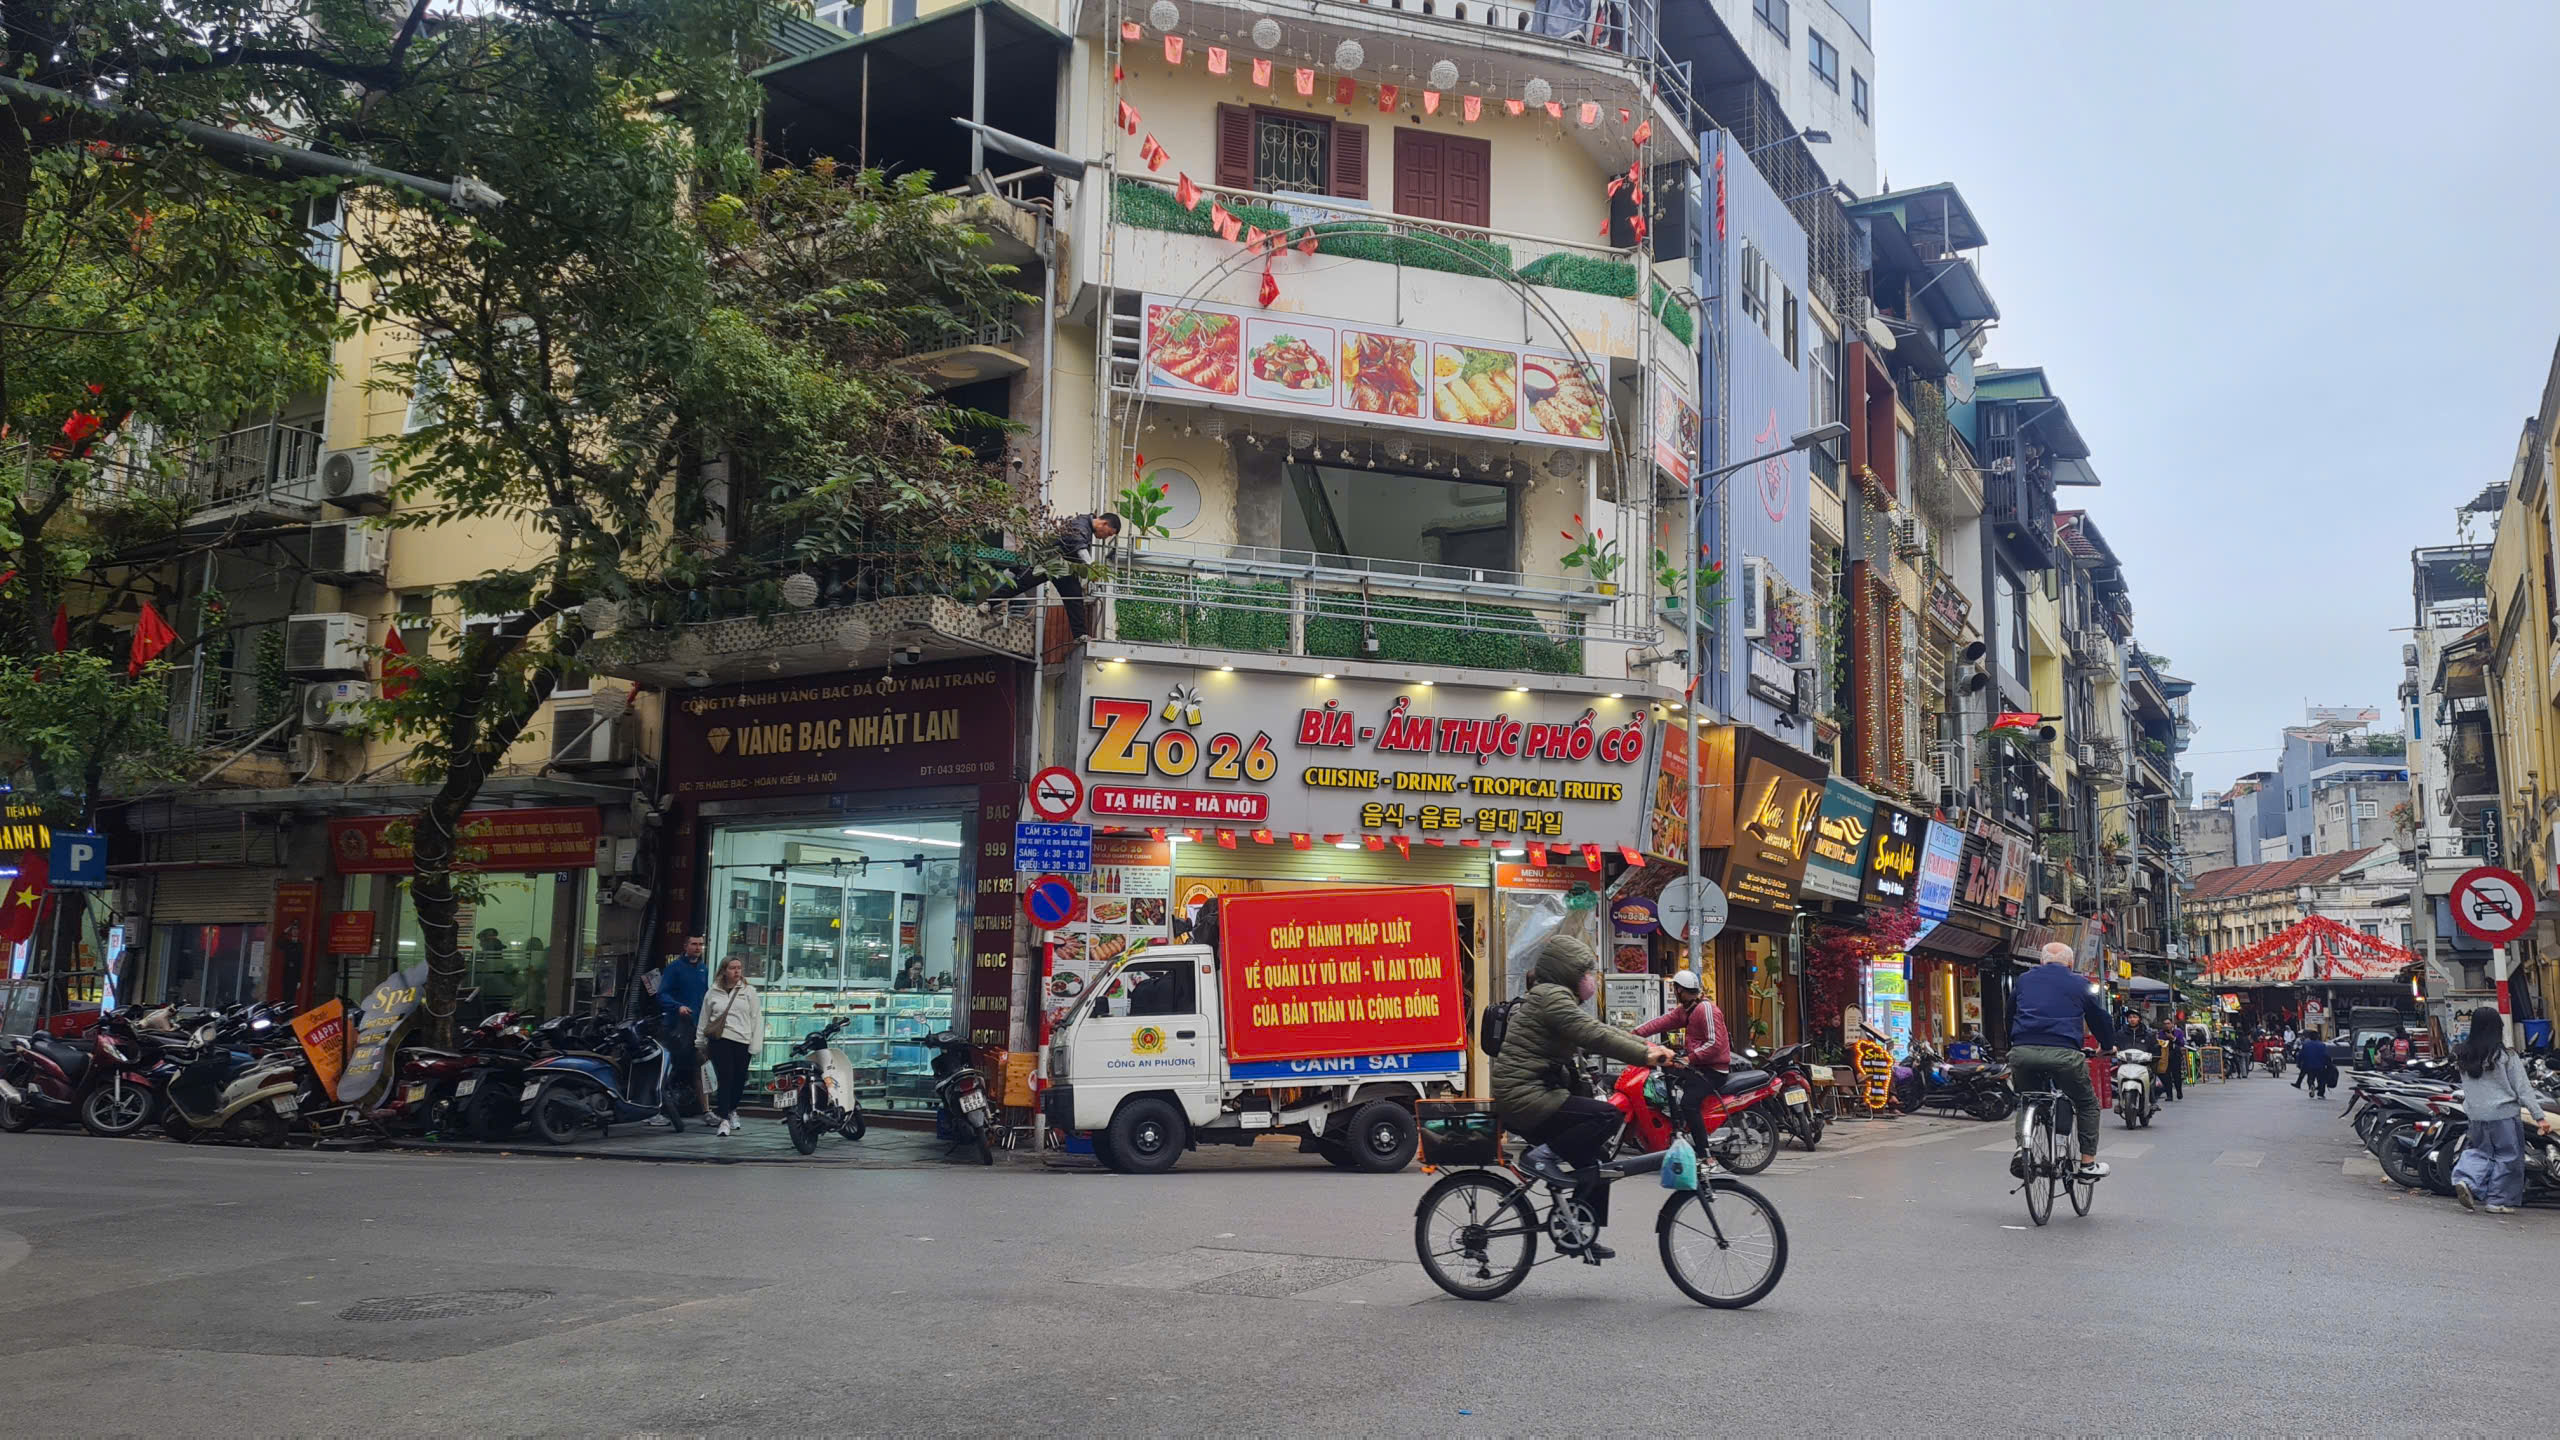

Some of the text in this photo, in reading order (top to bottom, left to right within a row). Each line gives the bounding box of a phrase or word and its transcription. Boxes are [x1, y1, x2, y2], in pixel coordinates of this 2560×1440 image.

[780, 687, 818, 703] VÀNG
[822, 685, 850, 702] BẠC
[853, 680, 873, 696] ĐÁ
[911, 676, 940, 691] MAI
[943, 671, 996, 687] TRANG
[737, 707, 960, 758] VÀNG BẠC NHẬT LAN
[1377, 697, 1436, 752] ẨM
[1438, 714, 1524, 766] THỰC
[1525, 708, 1598, 761] PHỐ
[1600, 710, 1648, 764] CỔ
[937, 765, 953, 776] 043
[955, 763, 976, 774] 9260
[1207, 730, 1278, 784] 26
[1304, 767, 1623, 801] CUISINE DRINK TROPICAL FRUITS
[986, 805, 1010, 822] BẠC
[1104, 791, 1257, 817] TẠ HIỆN HÀ NỘI
[1025, 824, 1040, 836] CẤM
[1042, 828, 1051, 836] XE
[1061, 828, 1067, 836] 16
[1362, 803, 1564, 836] 음식 음료 열대 과일
[2485, 811, 2499, 858] TATTOO
[71, 844, 93, 872] P
[985, 842, 1007, 857] 999
[1019, 846, 1039, 858] SÁNG:
[557, 871, 568, 882] 78
[978, 876, 1014, 896] BẠC Ý 925
[1521, 869, 1544, 877] MENU
[1000, 915, 1012, 930] 925
[1270, 916, 1412, 950] CHẤP HÀNH PHÁP LUẬT
[976, 953, 1007, 971] NGỌC
[1244, 953, 1441, 990] VỀ QUẢN LÝ VŨ KHÍ VÌ AN TOÀN
[372, 986, 417, 1013] Spa
[1252, 987, 1440, 1028] CỦA BẢN THÂN VÀ CỘNG ĐỒNG
[310, 1021, 341, 1045] HAPPY
[1107, 1057, 1136, 1070] CÔNG
[1139, 1058, 1153, 1069] AN
